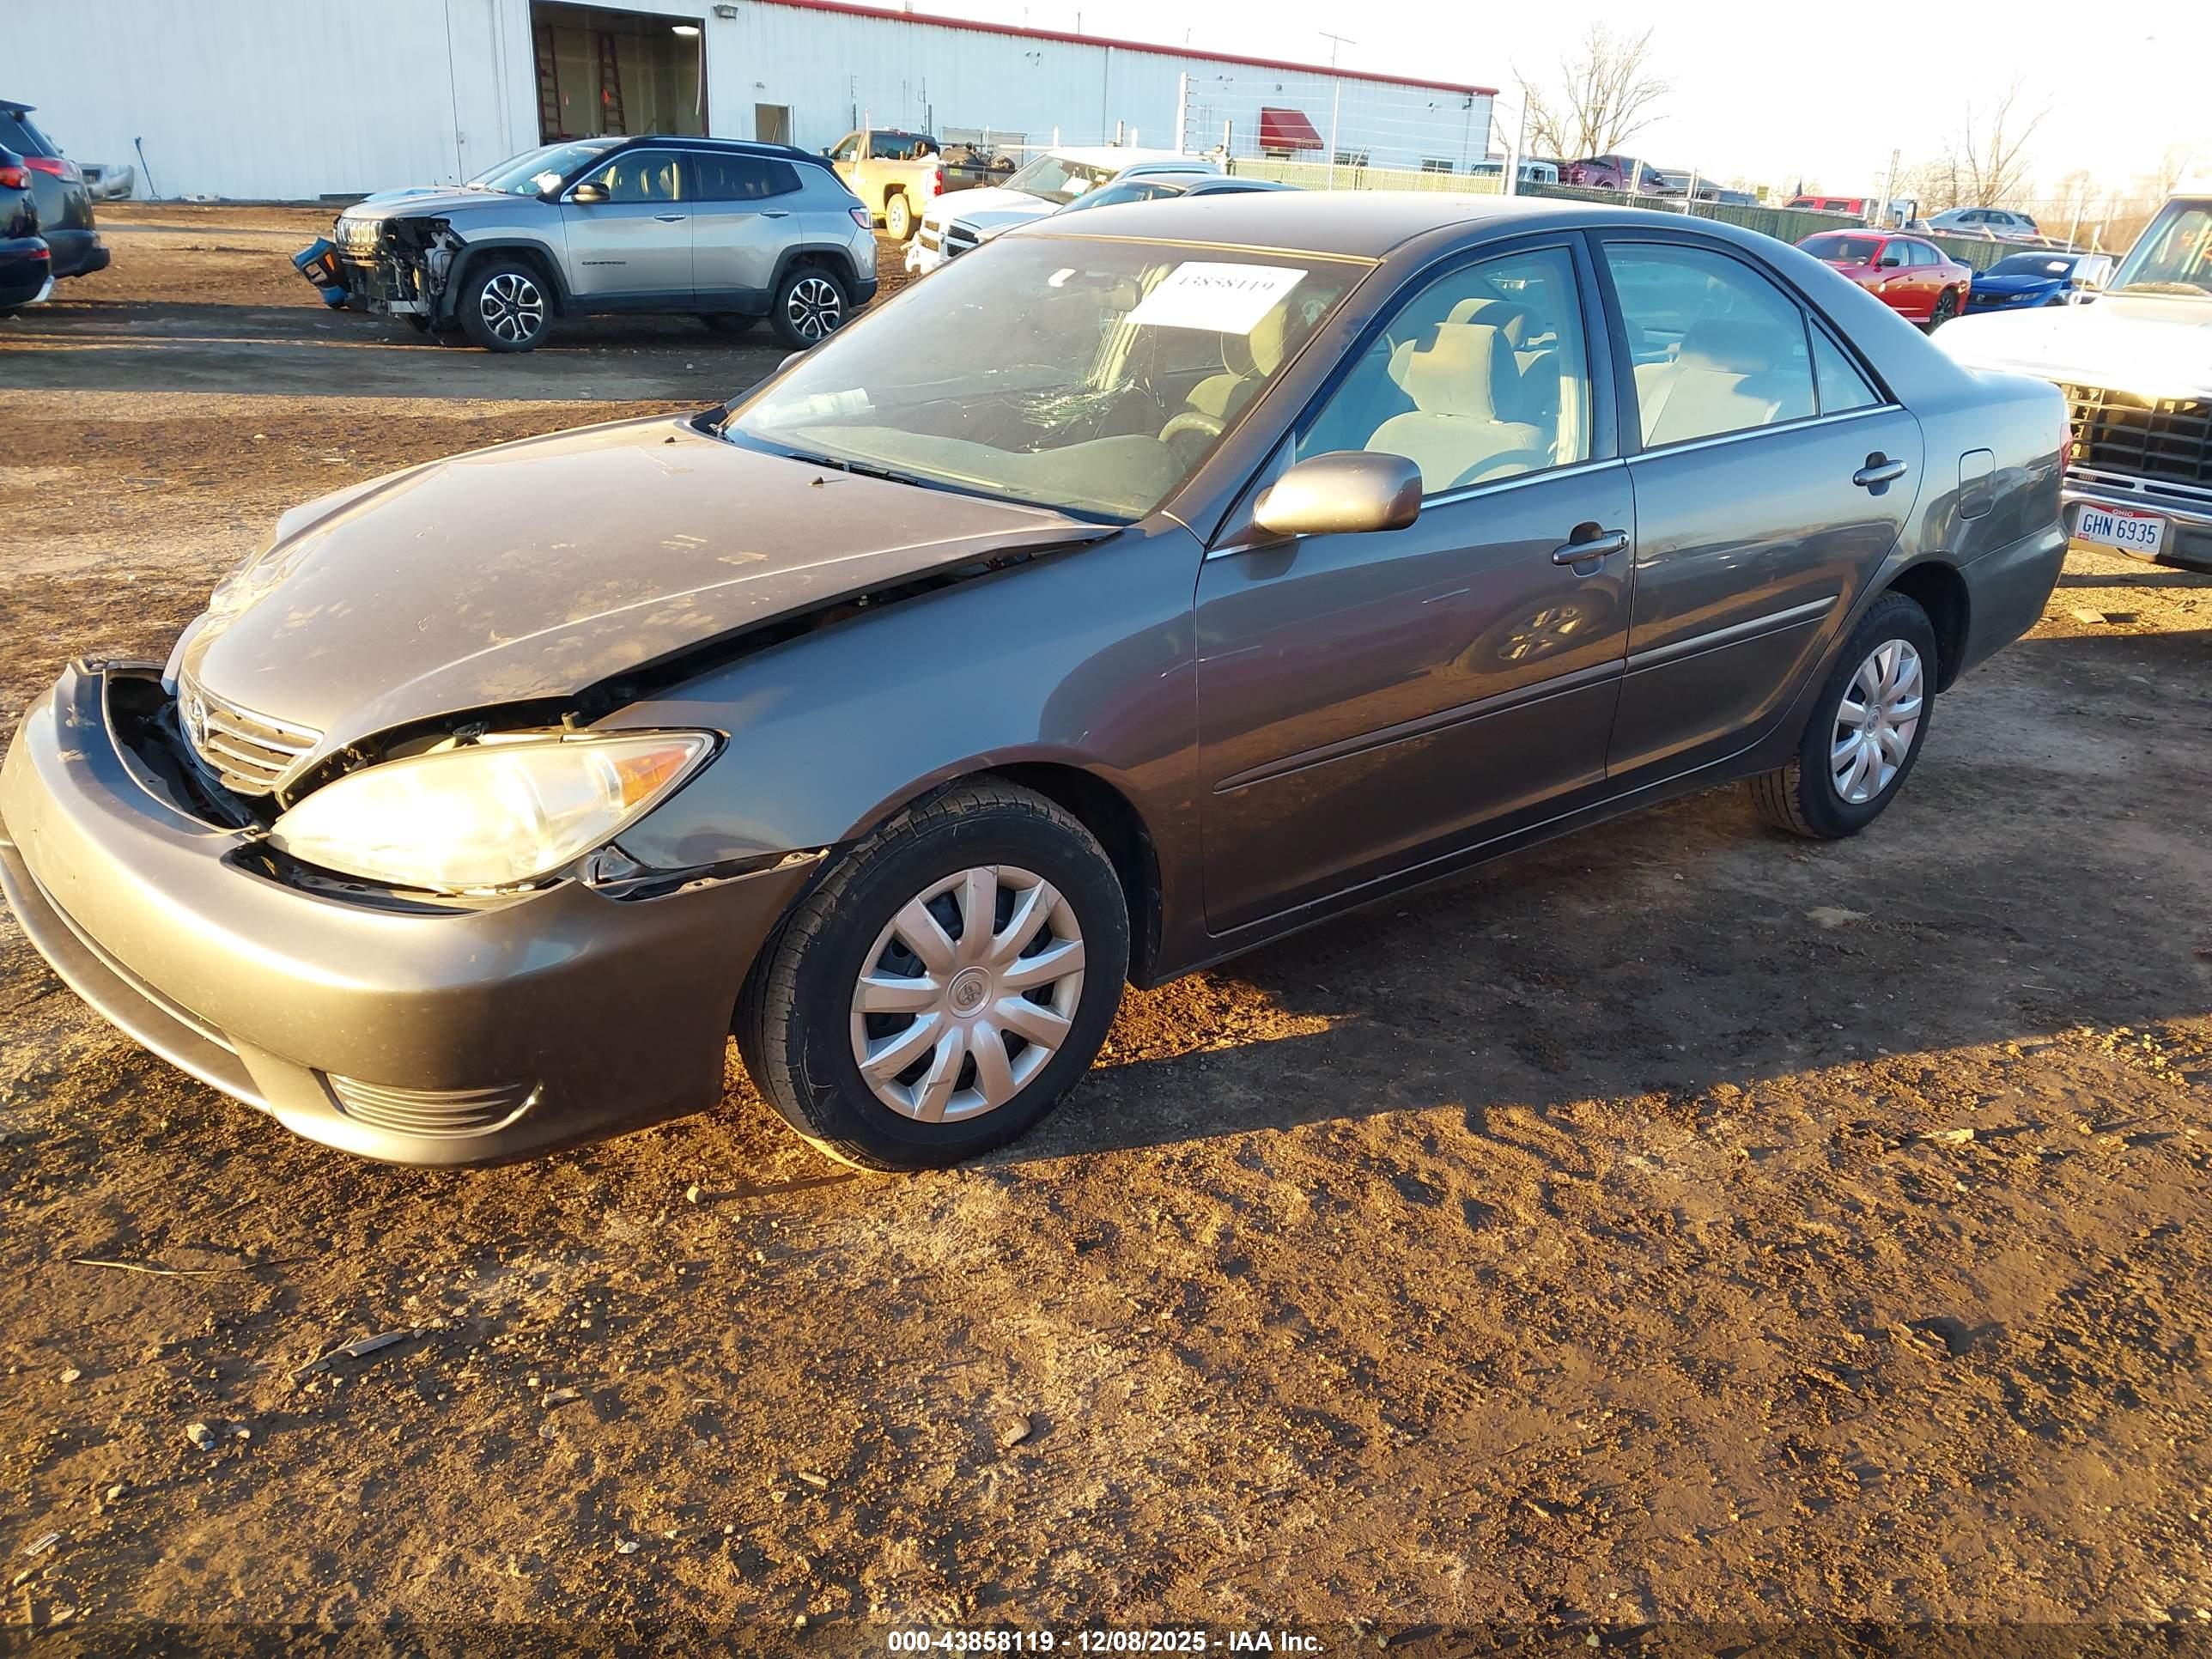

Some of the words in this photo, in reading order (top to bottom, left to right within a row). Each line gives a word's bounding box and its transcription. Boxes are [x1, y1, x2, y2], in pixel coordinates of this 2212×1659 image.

[2112, 508, 2134, 517] OHIO
[2082, 514, 2113, 537] GHN
[2116, 520, 2157, 544] 6935
